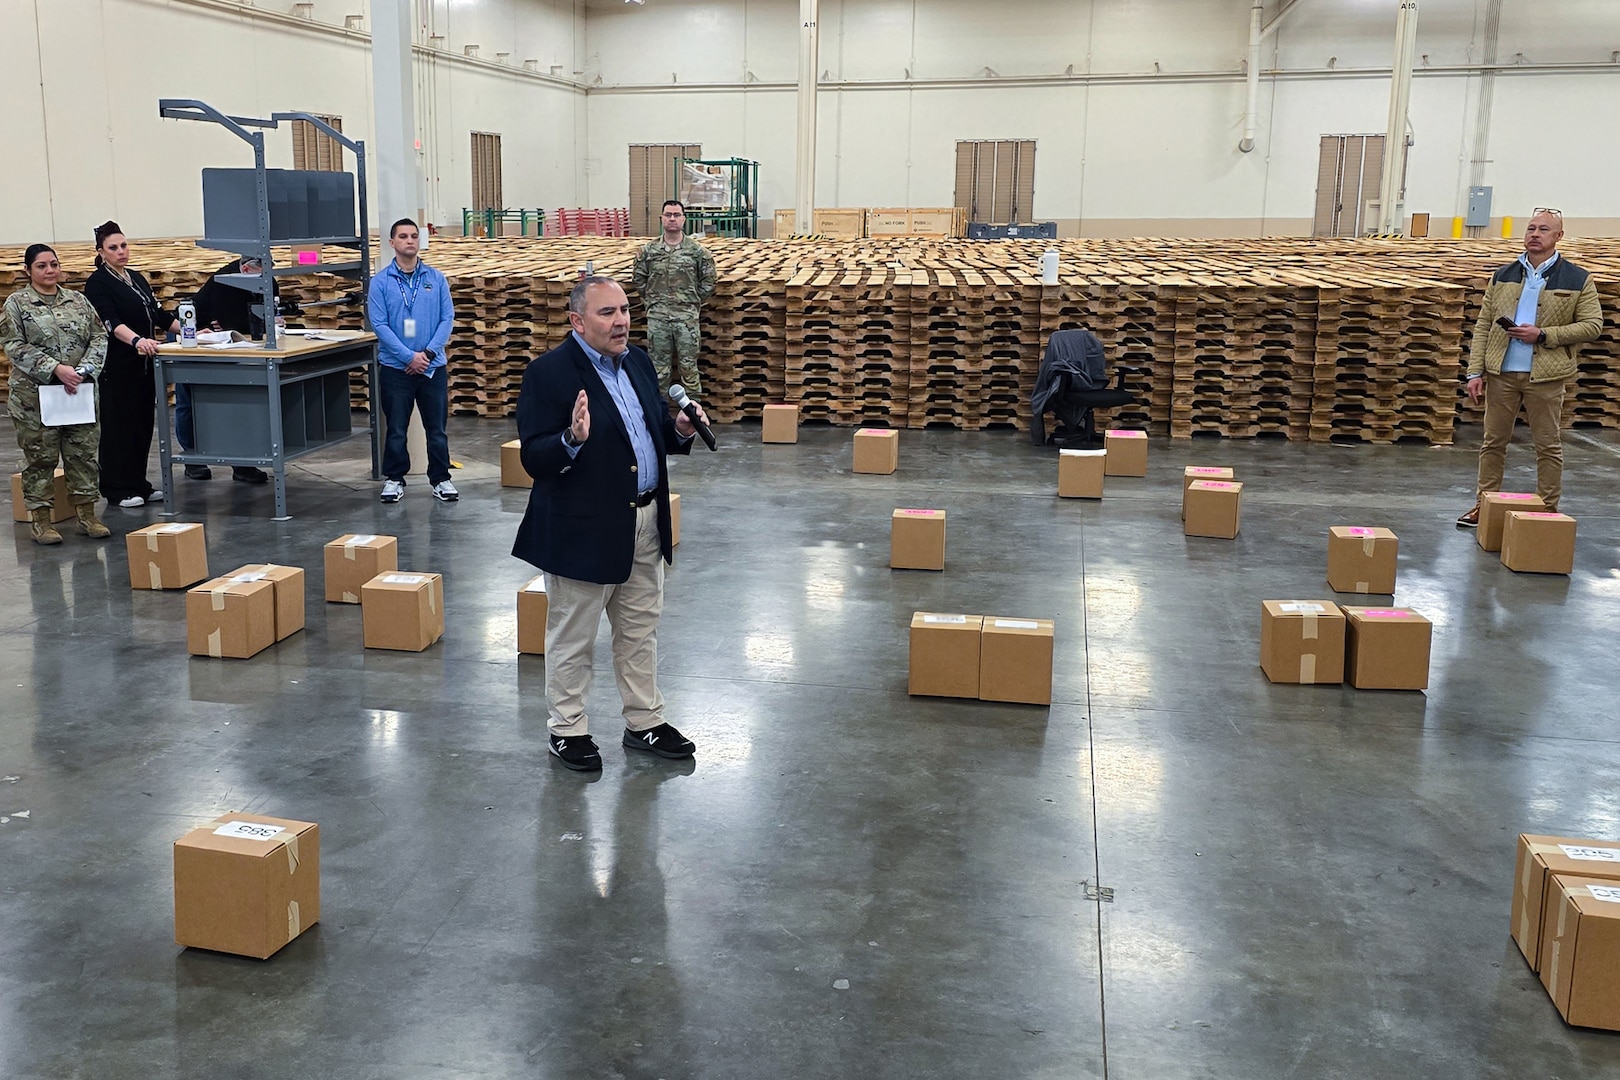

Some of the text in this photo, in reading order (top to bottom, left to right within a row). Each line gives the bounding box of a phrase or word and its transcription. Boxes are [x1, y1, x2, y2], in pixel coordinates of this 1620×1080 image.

[556, 738, 568, 752] N
[642, 731, 660, 746] N
[234, 825, 277, 837] 385
